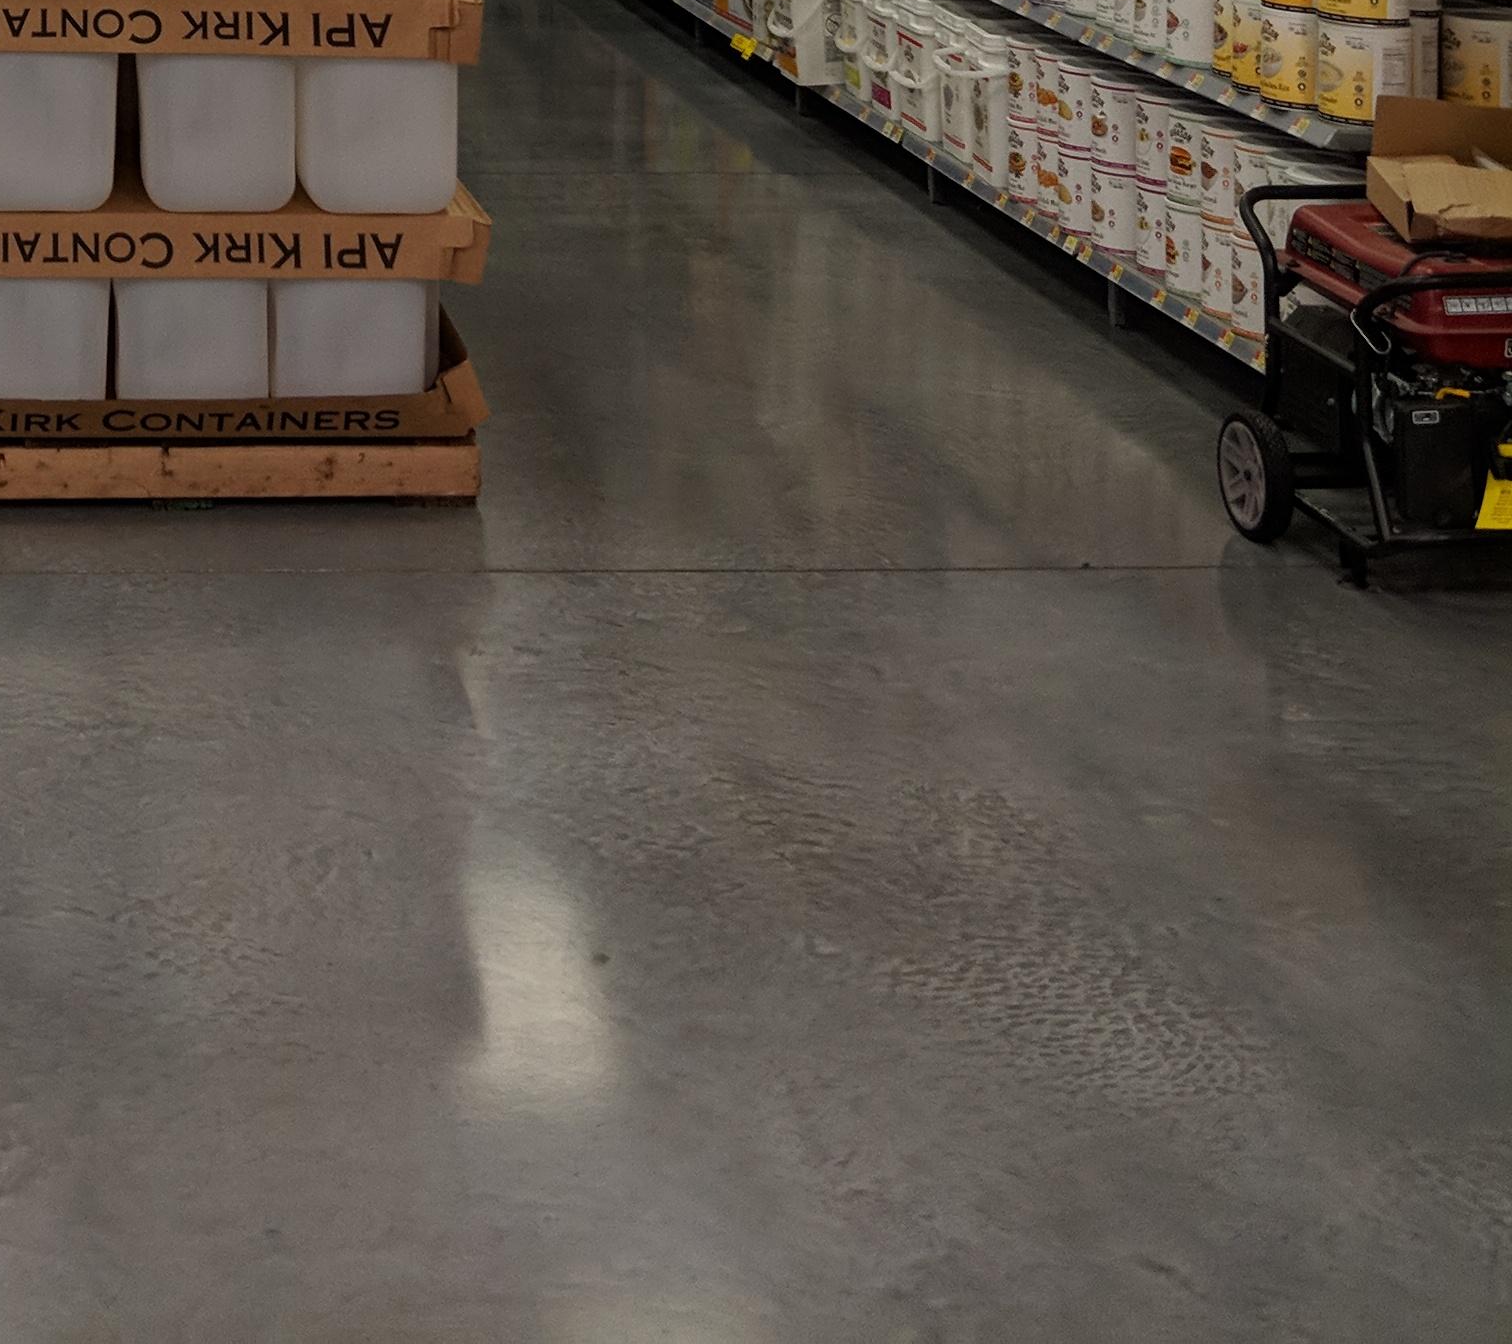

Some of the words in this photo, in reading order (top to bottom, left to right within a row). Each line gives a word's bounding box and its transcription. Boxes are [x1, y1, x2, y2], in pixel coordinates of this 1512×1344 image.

[181, 8, 290, 47] KIRK
[312, 12, 394, 50] API
[193, 231, 303, 269] KIRK
[323, 233, 404, 270] API
[101, 407, 401, 433] CONTAINERS
